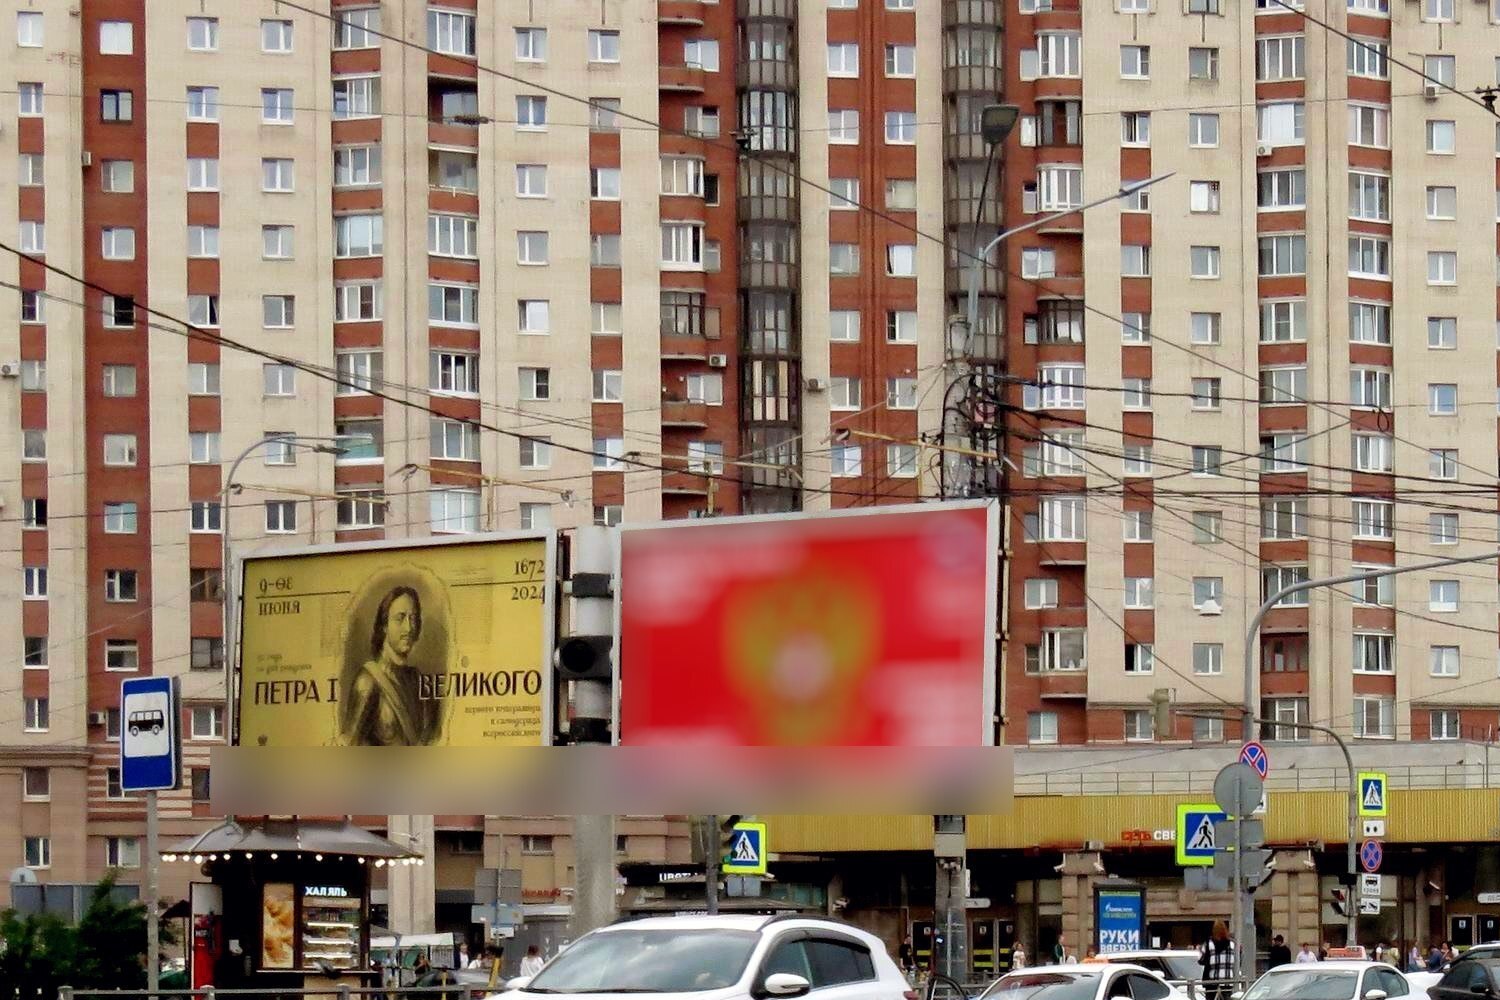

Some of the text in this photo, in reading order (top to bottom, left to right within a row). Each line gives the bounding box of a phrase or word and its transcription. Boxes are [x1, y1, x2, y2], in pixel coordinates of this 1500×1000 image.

[514, 560, 545, 579] 1672
[258, 601, 300, 616] ИЮНЯ
[254, 679, 320, 705] ПЕТРА
[419, 670, 542, 700] ВЕЛИКОГО
[1100, 929, 1139, 943] РУКИ
